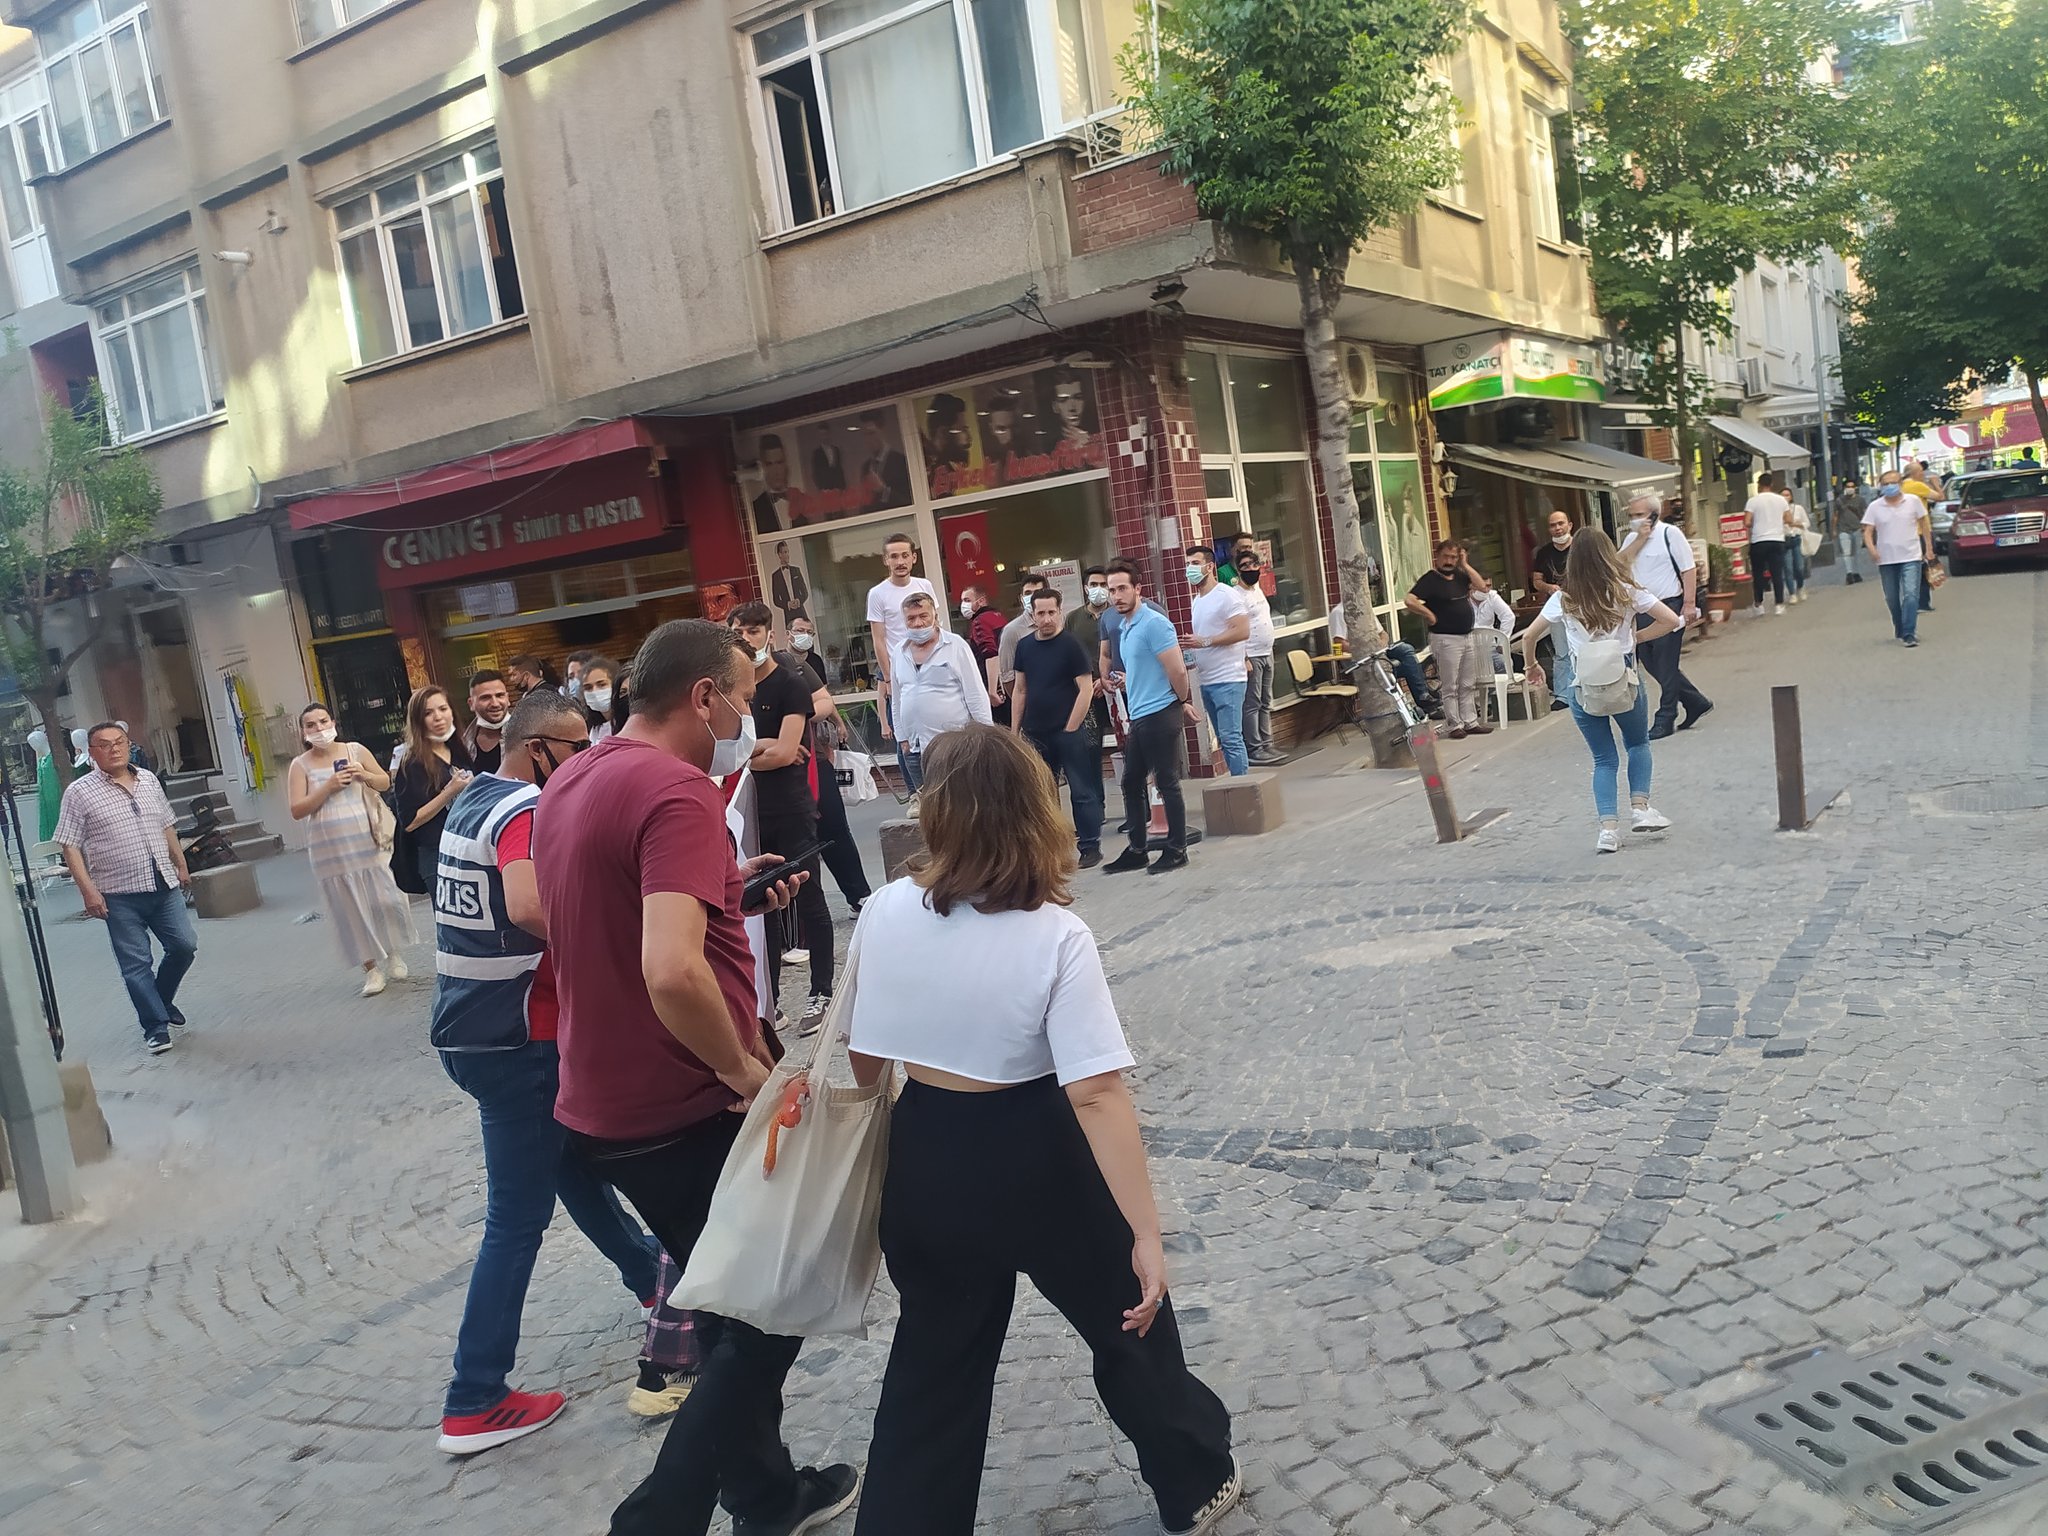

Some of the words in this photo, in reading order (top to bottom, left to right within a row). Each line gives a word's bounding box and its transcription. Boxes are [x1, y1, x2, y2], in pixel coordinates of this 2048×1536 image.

[1429, 366, 1448, 378] TAT
[383, 514, 503, 569] CENNET
[583, 496, 646, 530] PASTA
[1052, 567, 1076, 578] KURAL
